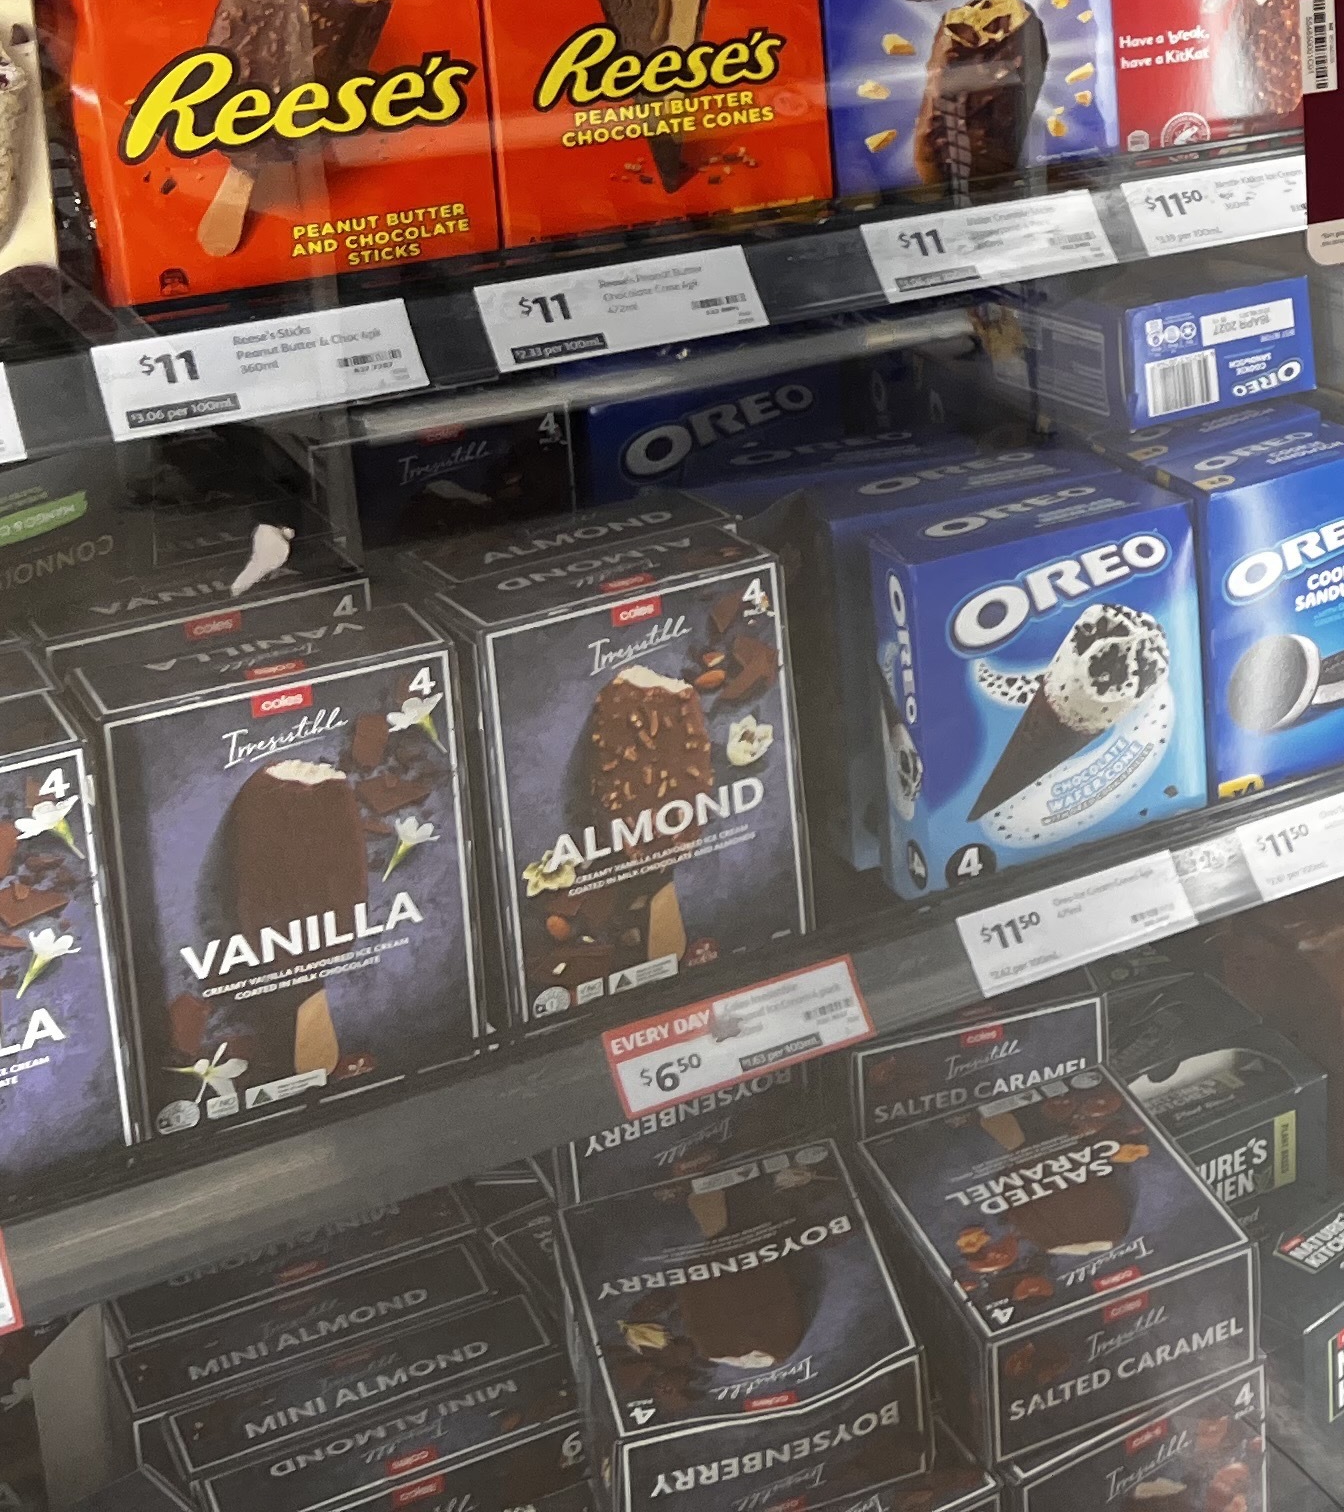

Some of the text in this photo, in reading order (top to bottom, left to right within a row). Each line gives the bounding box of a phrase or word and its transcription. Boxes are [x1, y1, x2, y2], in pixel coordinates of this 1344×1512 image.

[539, 27, 782, 111] Reese's
[1119, 32, 1154, 49] Have
[1120, 46, 1211, 69] have KitKat
[122, 54, 471, 160] Reese's
[561, 105, 776, 149] CHOCOLATE CONES
[573, 90, 755, 128] PEANUT BUTTER
[291, 219, 471, 258] AND CHOCOLATE
[292, 202, 466, 242] PEANUT BUTTER
[348, 242, 422, 266] STICKS
[952, 536, 1168, 651] OREO
[222, 707, 349, 770] Irresistible
[543, 775, 766, 875] ALMOND
[180, 892, 425, 981] VANILLA
[202, 935, 410, 998] CREAMY VANILLA FLAVOURED ICE CREAM
[234, 985, 276, 1001] COATED
[290, 971, 318, 990] MILK
[319, 955, 381, 981] CHOCOLATE
[610, 1008, 711, 1056] EVERY DAY
[598, 1215, 853, 1301] BOYSENBERRY
[187, 1289, 429, 1381] MINI ALMOND
[1006, 1316, 1245, 1423] SALTED CARAMEL
